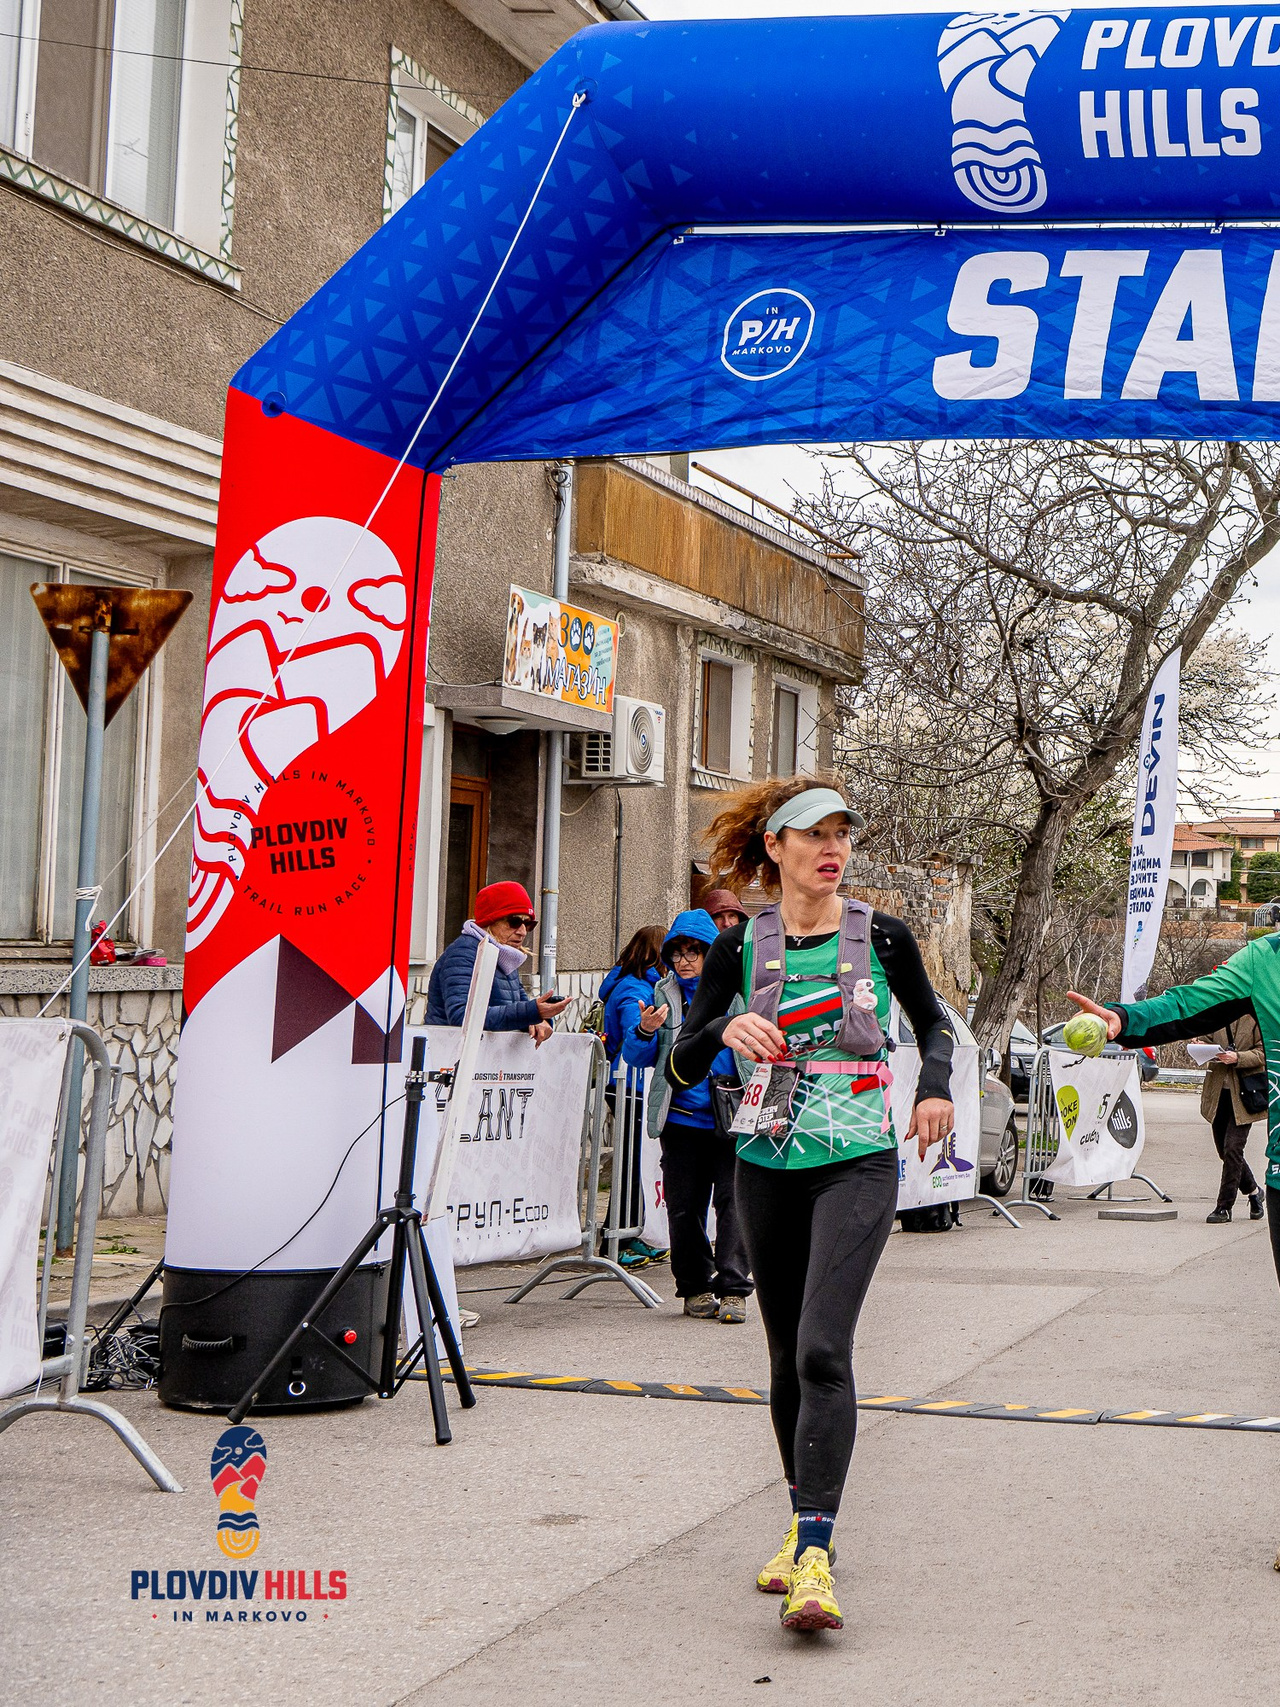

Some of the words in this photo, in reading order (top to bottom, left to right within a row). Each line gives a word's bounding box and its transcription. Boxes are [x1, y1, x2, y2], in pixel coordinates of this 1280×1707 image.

[1080, 87, 1262, 158] HILLS
[766, 307, 778, 315] IN
[738, 317, 801, 346] P/H
[732, 345, 791, 355] MARKOVO
[544, 656, 606, 705] МАГАЗИН
[1141, 693, 1166, 836] DEVIN
[228, 794, 251, 862] PLOVDIV
[254, 770, 301, 794] HILLS
[311, 771, 328, 782] IN
[336, 780, 376, 846] MARKOVO
[251, 817, 348, 849] PLOVDIV
[270, 847, 335, 874] HILLS
[243, 885, 284, 914] TRAIL
[295, 903, 327, 916] RUN
[334, 873, 366, 905] RACE
[1111, 1108, 1132, 1131] hills
